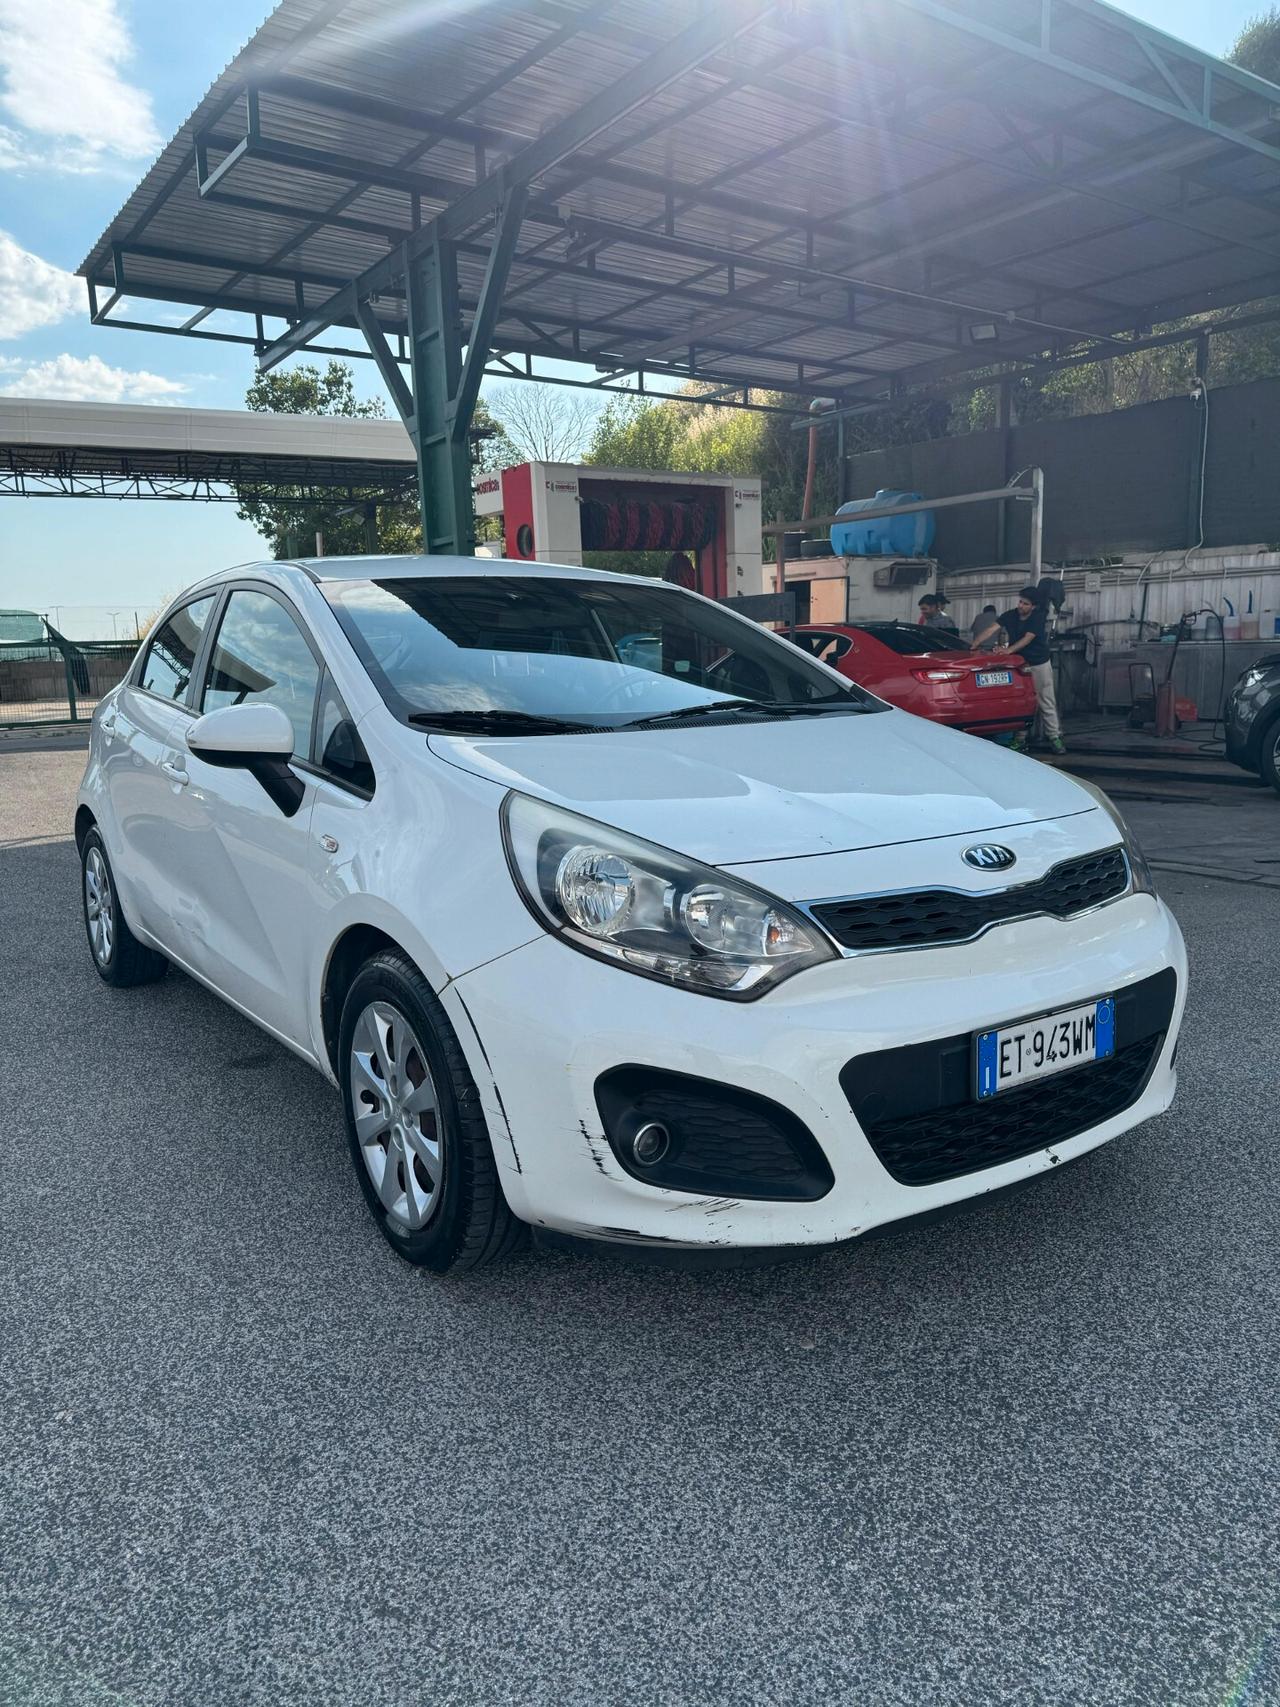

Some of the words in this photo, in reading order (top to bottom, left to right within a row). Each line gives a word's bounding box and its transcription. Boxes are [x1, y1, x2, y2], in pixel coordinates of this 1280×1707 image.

[968, 846, 1013, 866] KIA
[1000, 1035, 1025, 1078] ET
[1033, 1014, 1095, 1068] 943WM
